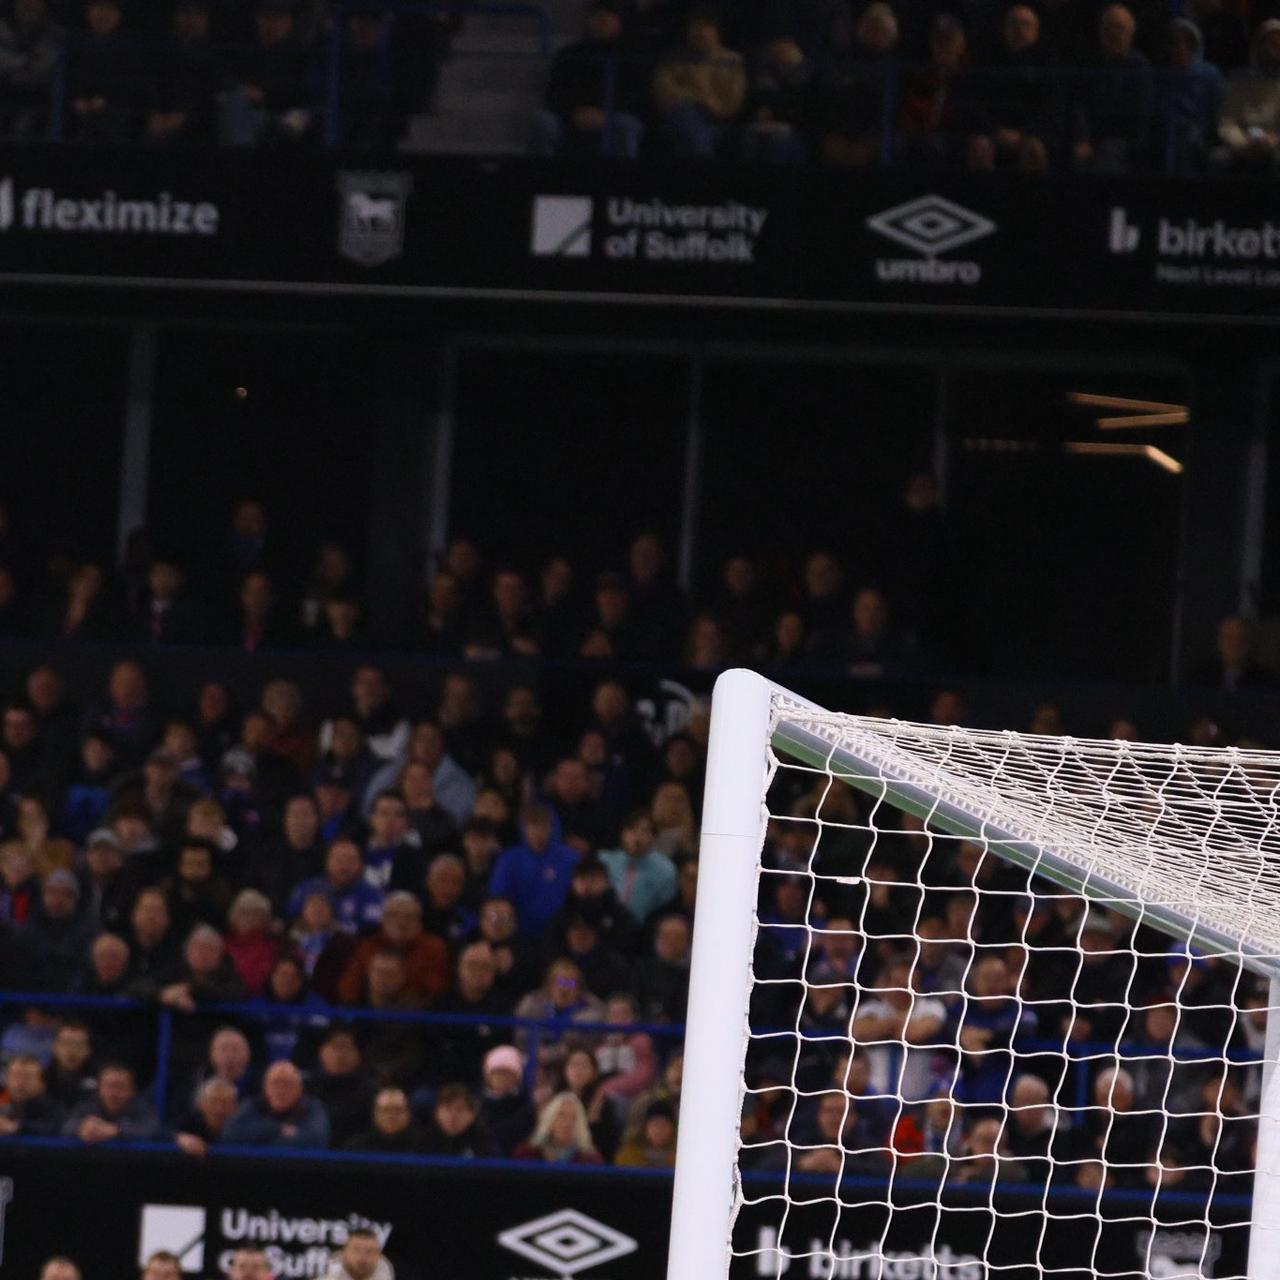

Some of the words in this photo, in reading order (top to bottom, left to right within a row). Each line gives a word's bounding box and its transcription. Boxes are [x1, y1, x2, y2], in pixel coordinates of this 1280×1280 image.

[22, 187, 220, 236] fleximize
[608, 199, 768, 237] University
[606, 231, 639, 258] of
[645, 231, 756, 263] Suffolk
[1157, 217, 1280, 258] birket
[875, 257, 981, 284] umbro
